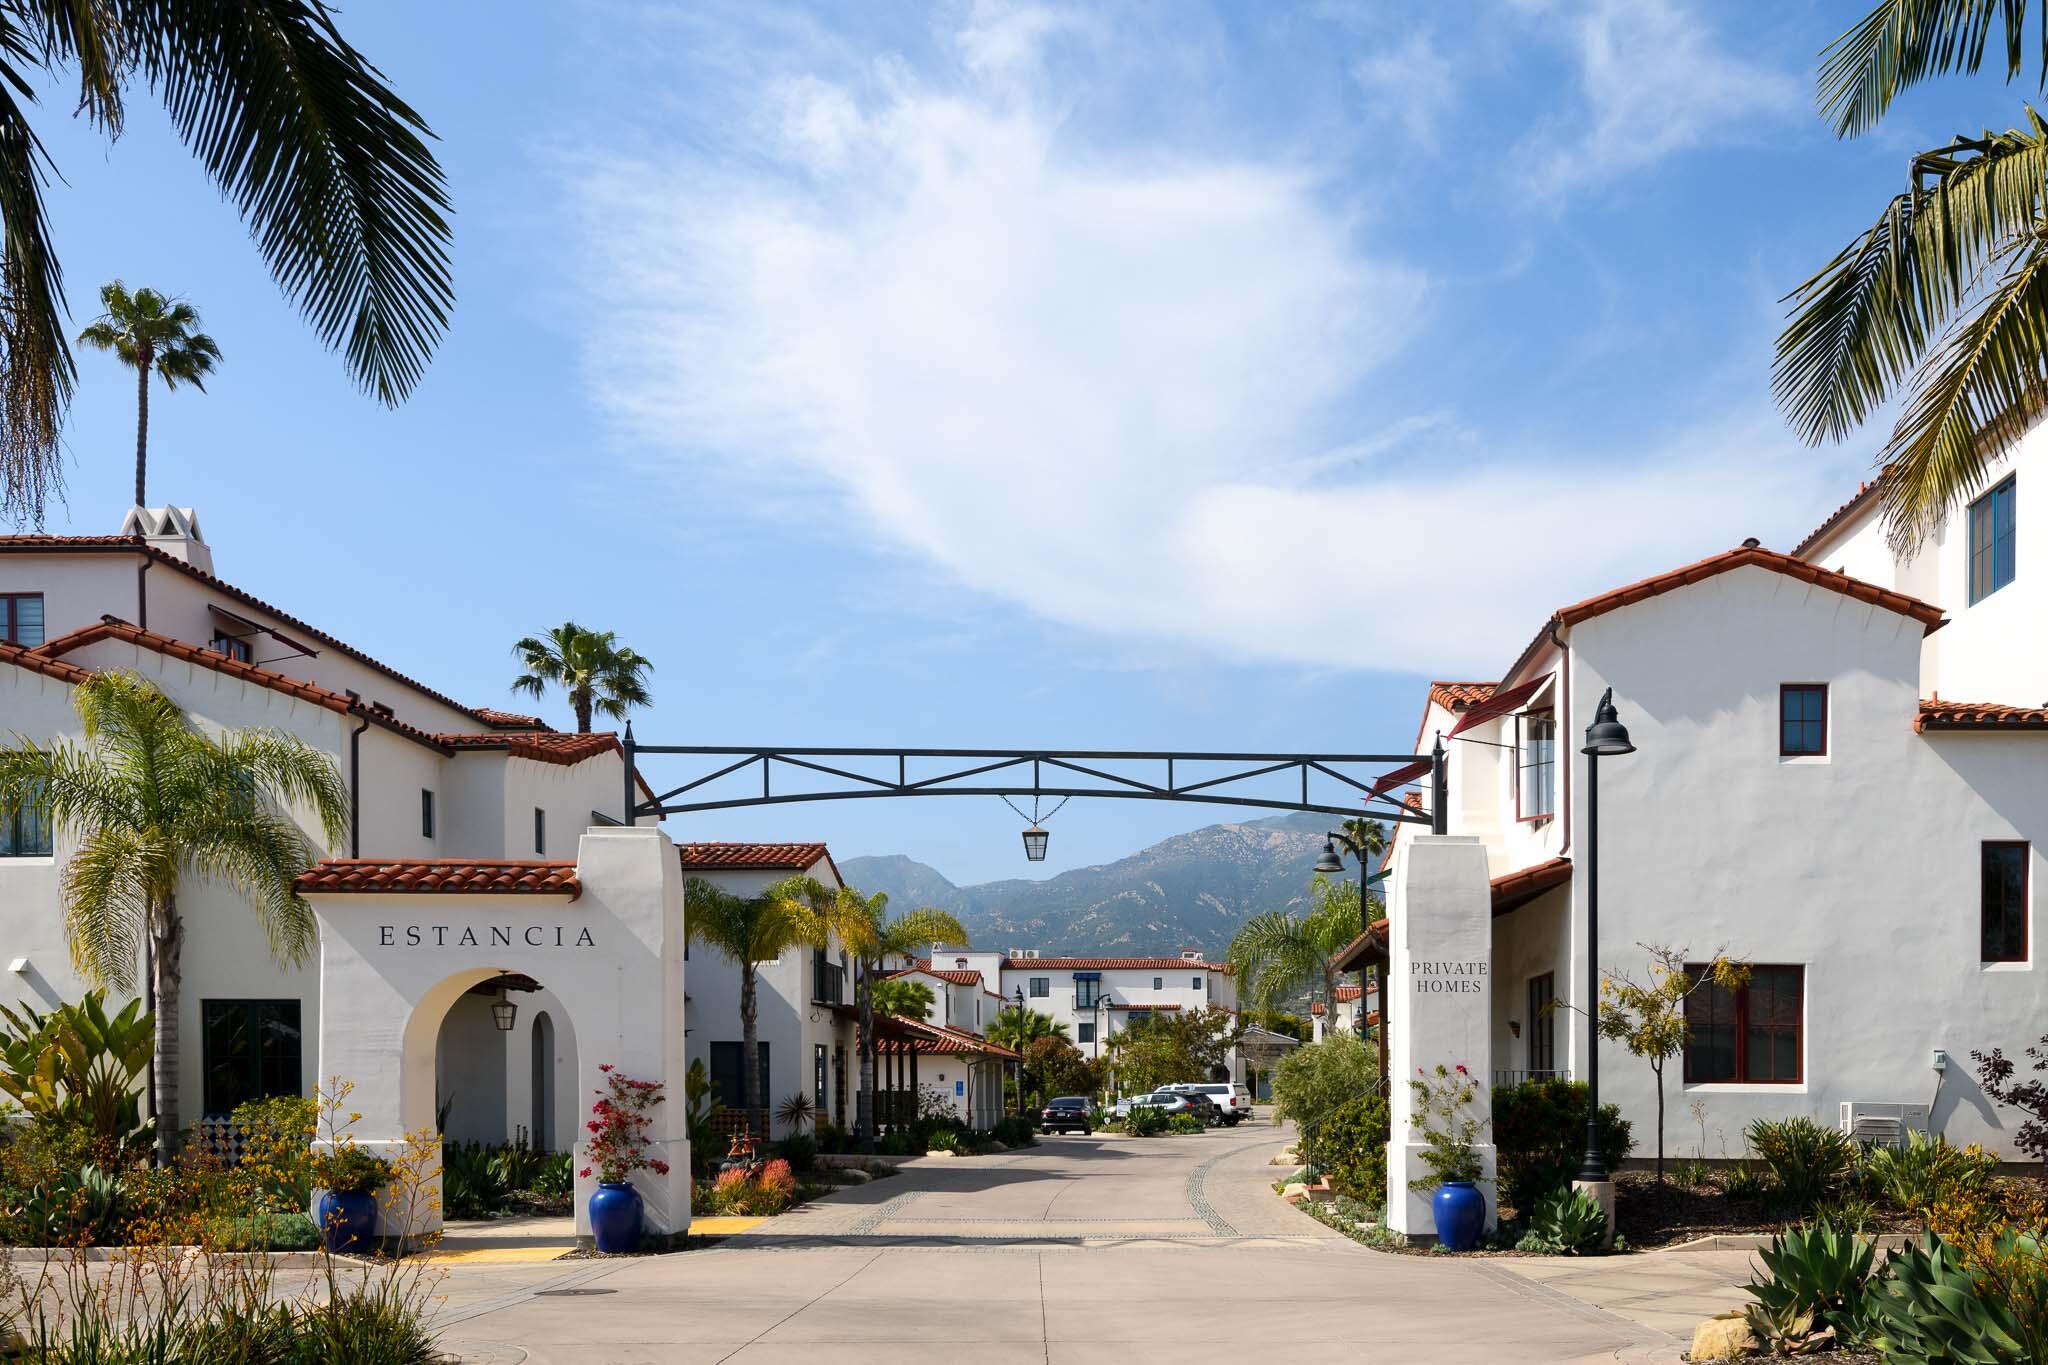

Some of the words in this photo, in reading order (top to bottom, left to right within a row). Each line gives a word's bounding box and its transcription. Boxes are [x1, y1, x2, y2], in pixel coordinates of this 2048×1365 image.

[378, 925, 596, 947] ESTANCIA
[1411, 961, 1488, 975] PRIVATE
[1417, 979, 1481, 993] HOMES
